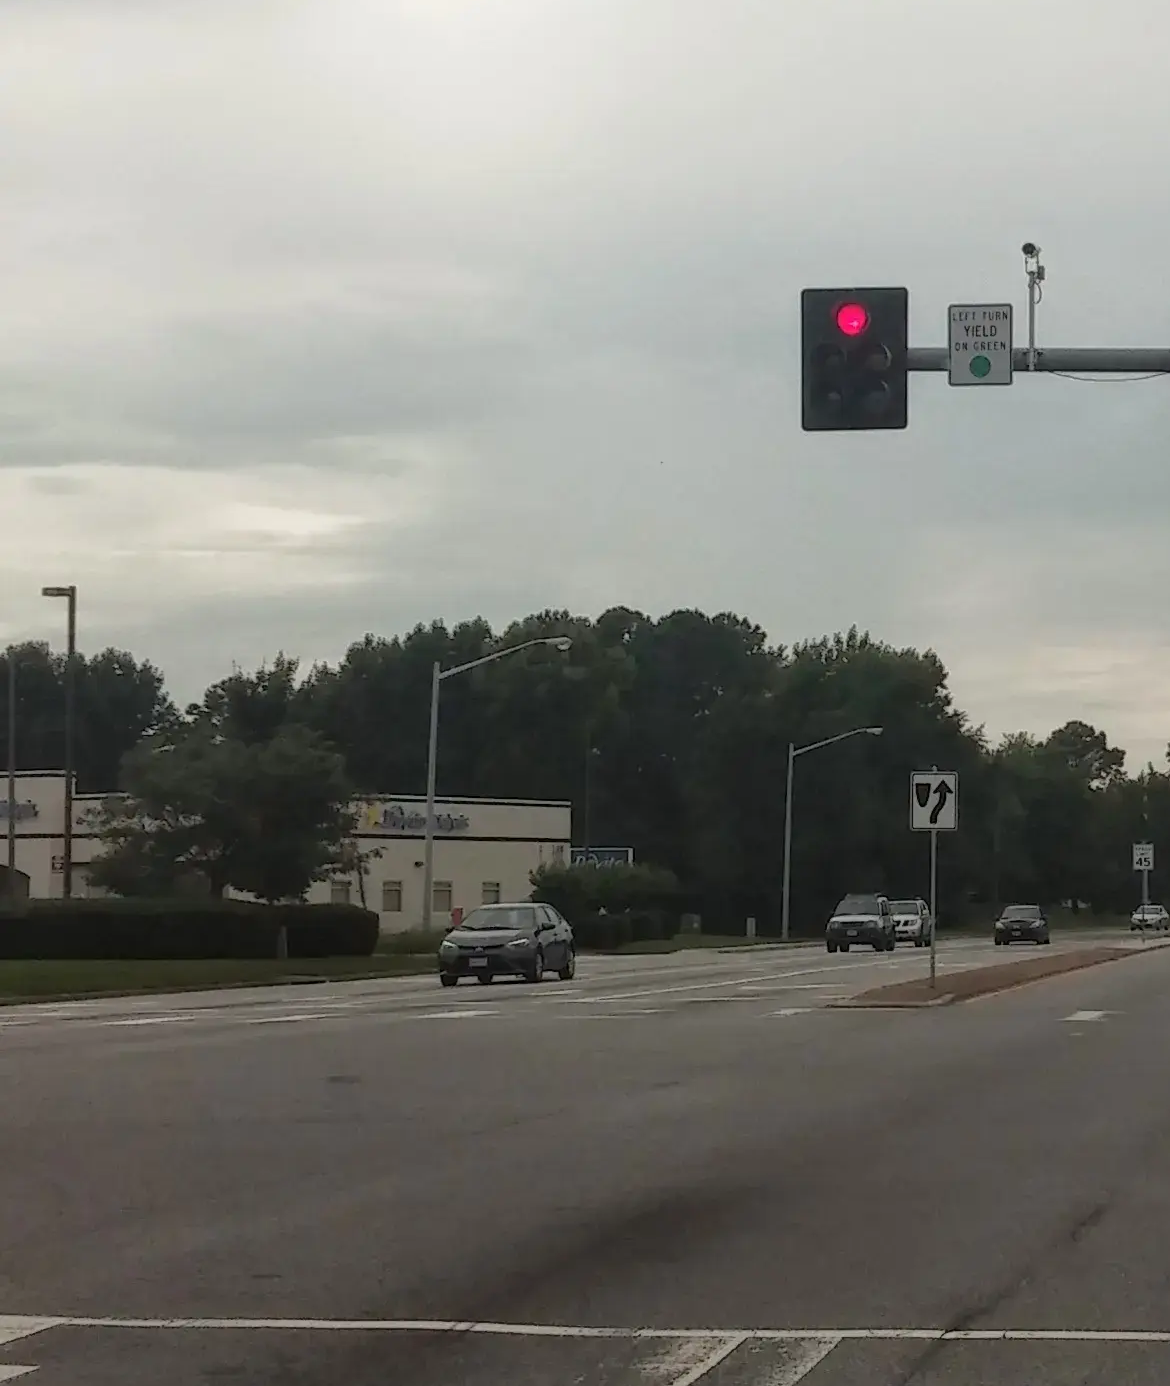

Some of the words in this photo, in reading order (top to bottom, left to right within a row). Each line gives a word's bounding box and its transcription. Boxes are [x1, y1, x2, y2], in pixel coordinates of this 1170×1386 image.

[952, 311, 976, 321] LEFT
[982, 310, 1008, 321] TURN
[964, 324, 997, 337] YIELD
[955, 342, 968, 352] ON
[973, 341, 1006, 352] GREEN
[1135, 857, 1151, 867] 45
